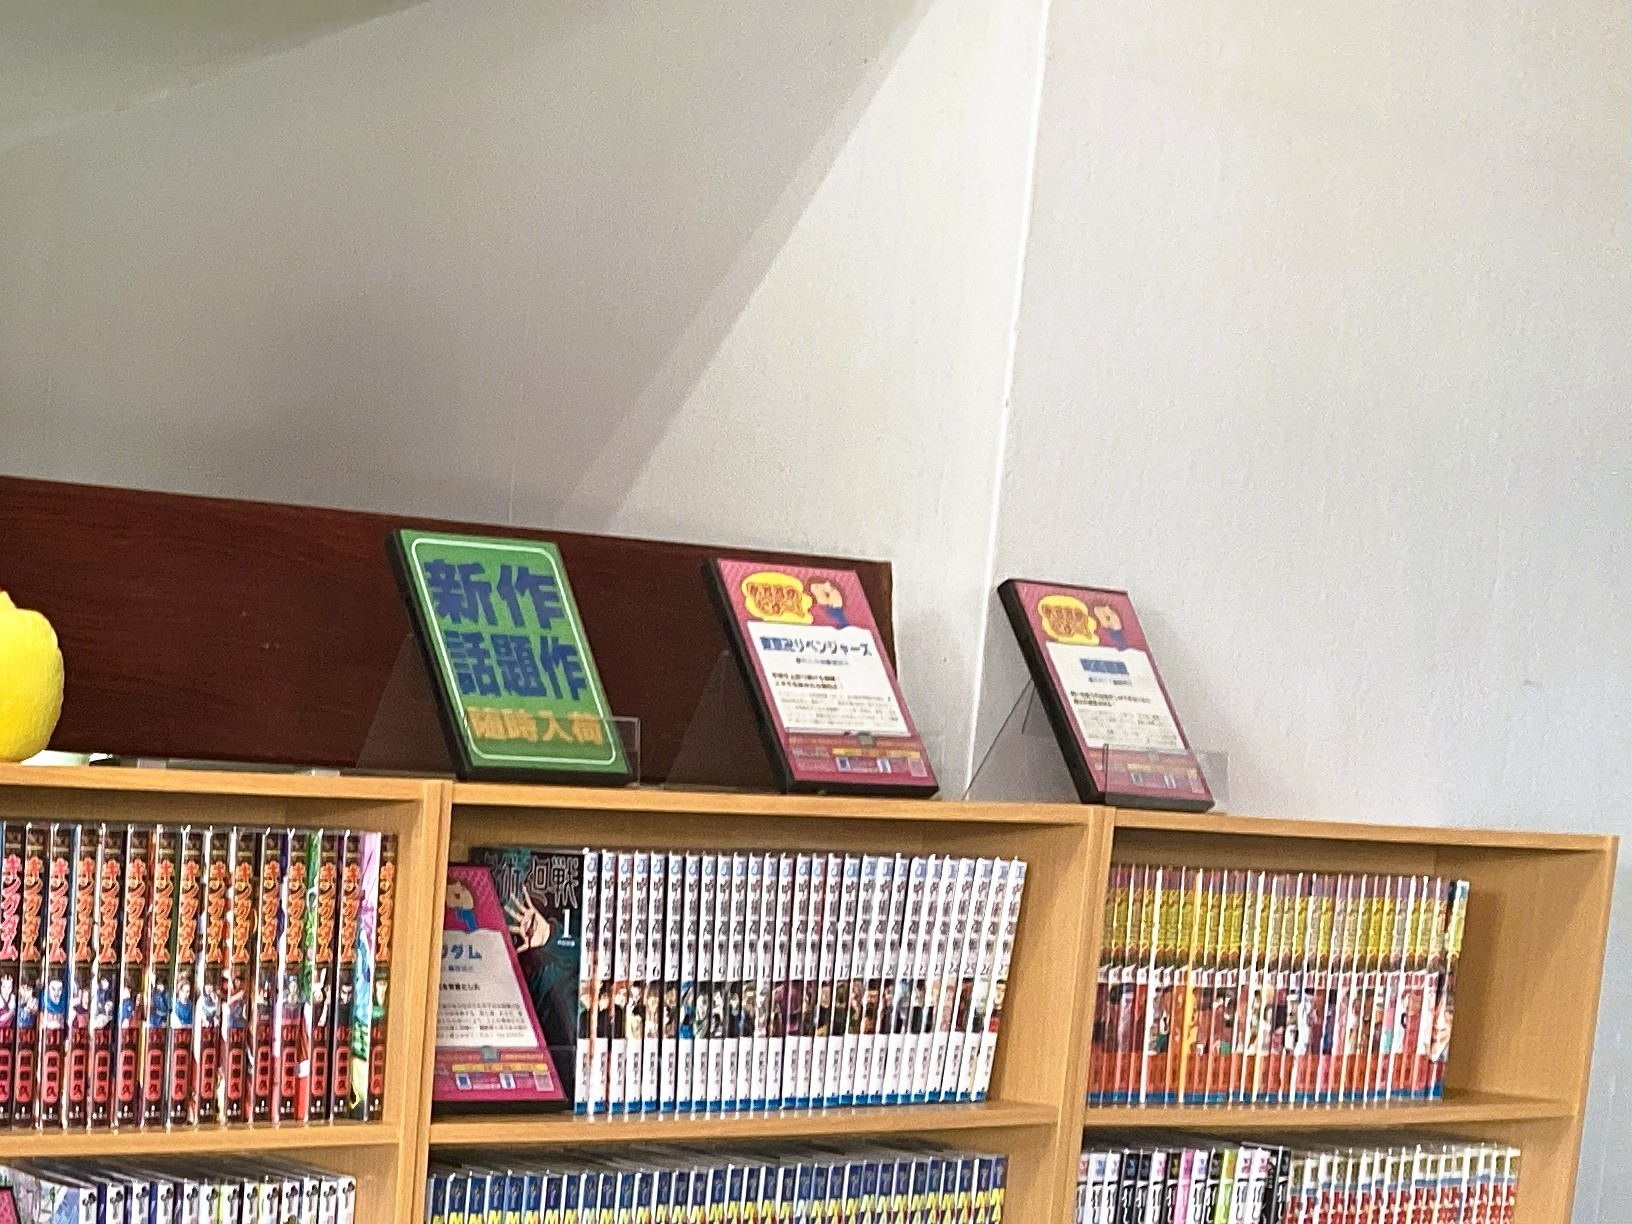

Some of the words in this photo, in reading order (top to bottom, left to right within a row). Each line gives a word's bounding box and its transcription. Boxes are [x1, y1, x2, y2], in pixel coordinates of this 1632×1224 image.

[424, 559, 565, 630] 新作
[444, 630, 587, 700] 話題作
